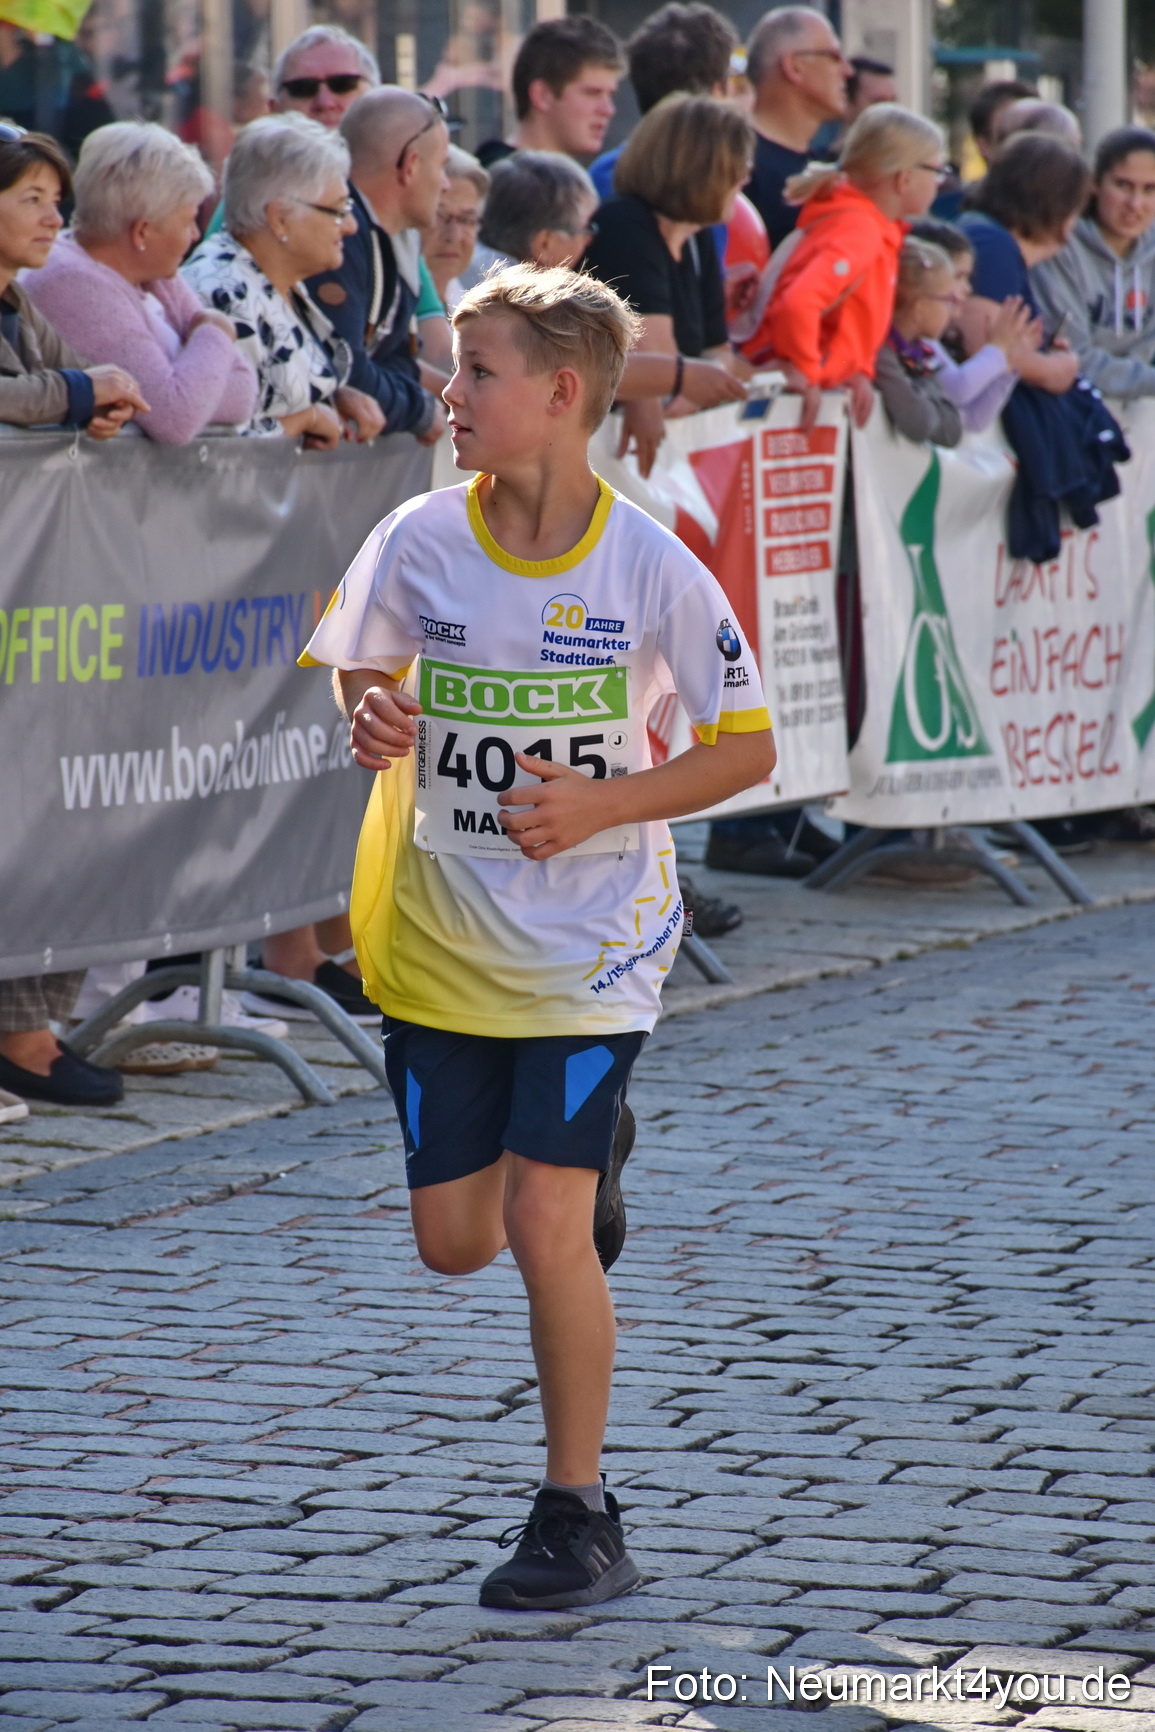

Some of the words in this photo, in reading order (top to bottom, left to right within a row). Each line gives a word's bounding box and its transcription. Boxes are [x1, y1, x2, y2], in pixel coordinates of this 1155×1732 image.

[545, 602, 584, 630] 20
[588, 620, 622, 631] JAHRE
[0, 604, 125, 685] FFICE
[137, 592, 305, 678] INDUSTRY
[543, 630, 631, 651] Neumarkter
[540, 649, 614, 666] Stadtlauf
[431, 667, 612, 719] BOCK
[614, 735, 622, 746] J
[453, 808, 508, 836] MA
